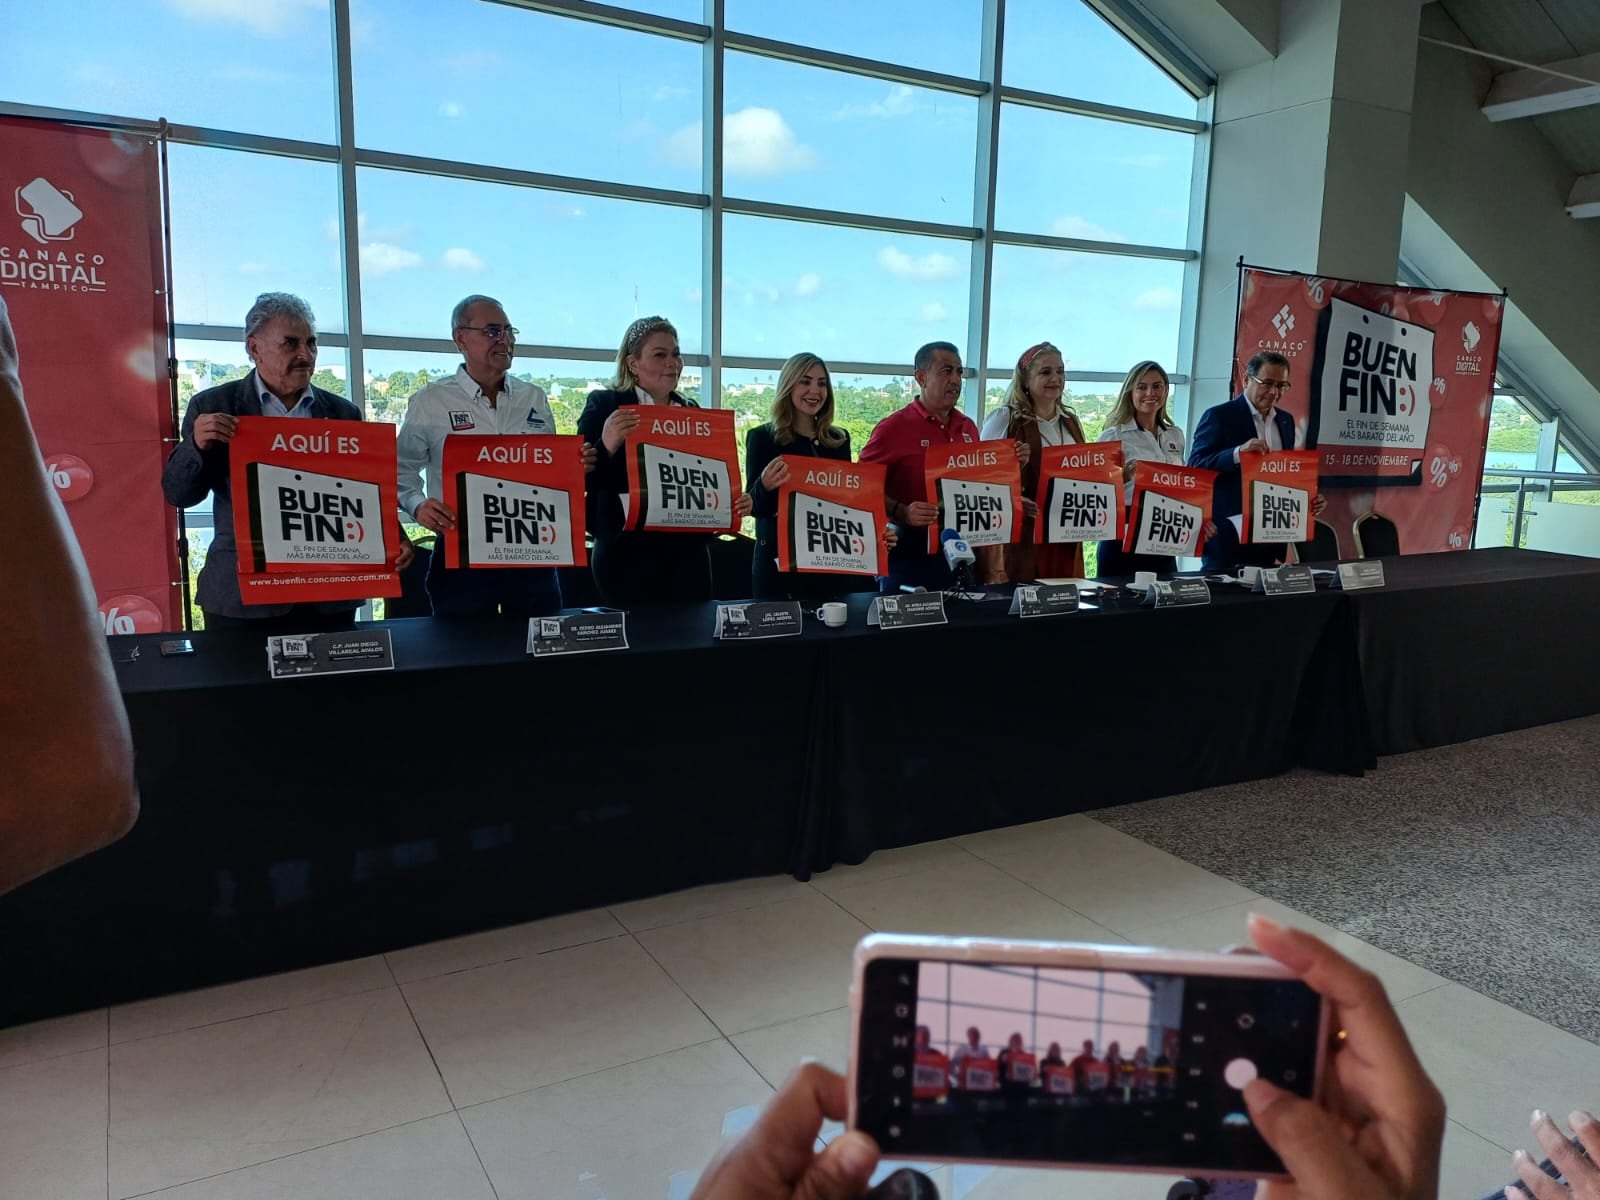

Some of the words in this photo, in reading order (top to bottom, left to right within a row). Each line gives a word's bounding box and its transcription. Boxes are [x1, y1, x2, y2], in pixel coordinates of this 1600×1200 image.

[0, 247, 104, 264] CANACO
[1, 260, 106, 285] DIGITAL
[21, 282, 88, 292] TAMPICO
[1258, 340, 1302, 350] CANACO
[1342, 332, 1416, 382] BUEN
[1456, 362, 1480, 372] DIGITAL
[652, 417, 690, 435] AQUÍ
[696, 422, 710, 436] ES
[1347, 420, 1354, 428] EL
[1356, 420, 1367, 430] FIN
[1370, 421, 1378, 430] DE
[1381, 422, 1410, 432] SEMANA
[271, 431, 329, 453] AQUÍ
[338, 437, 360, 454] ES
[1358, 432, 1384, 440] BARATO
[1386, 434, 1397, 442] DEL
[1400, 432, 1414, 442] AÑO
[477, 443, 528, 463] AQUÍ
[534, 448, 552, 464] ES
[946, 449, 979, 468] AQUÍ
[984, 452, 997, 465] ES
[1061, 450, 1090, 468] AQUÍ
[1094, 453, 1105, 466] ES
[1326, 454, 1335, 464] 15
[1342, 454, 1350, 464] 18
[1353, 455, 1364, 464] DE
[1365, 456, 1408, 466] NOVIEMBRE
[1260, 458, 1287, 473] AQUÍ
[1290, 461, 1300, 472] ES
[658, 462, 718, 490] BUEN
[805, 470, 842, 486] AQUÍ
[846, 475, 860, 488] ES
[1152, 472, 1182, 486] AQUÍ
[1184, 476, 1196, 487] ES
[278, 486, 363, 518] BUEN
[483, 493, 556, 522] BUEN
[954, 494, 1002, 511] BUEN
[1062, 492, 1108, 509] BUEN
[1262, 494, 1300, 512] BUEN
[807, 510, 864, 536] BUEN
[1152, 506, 1194, 530] BUEN
